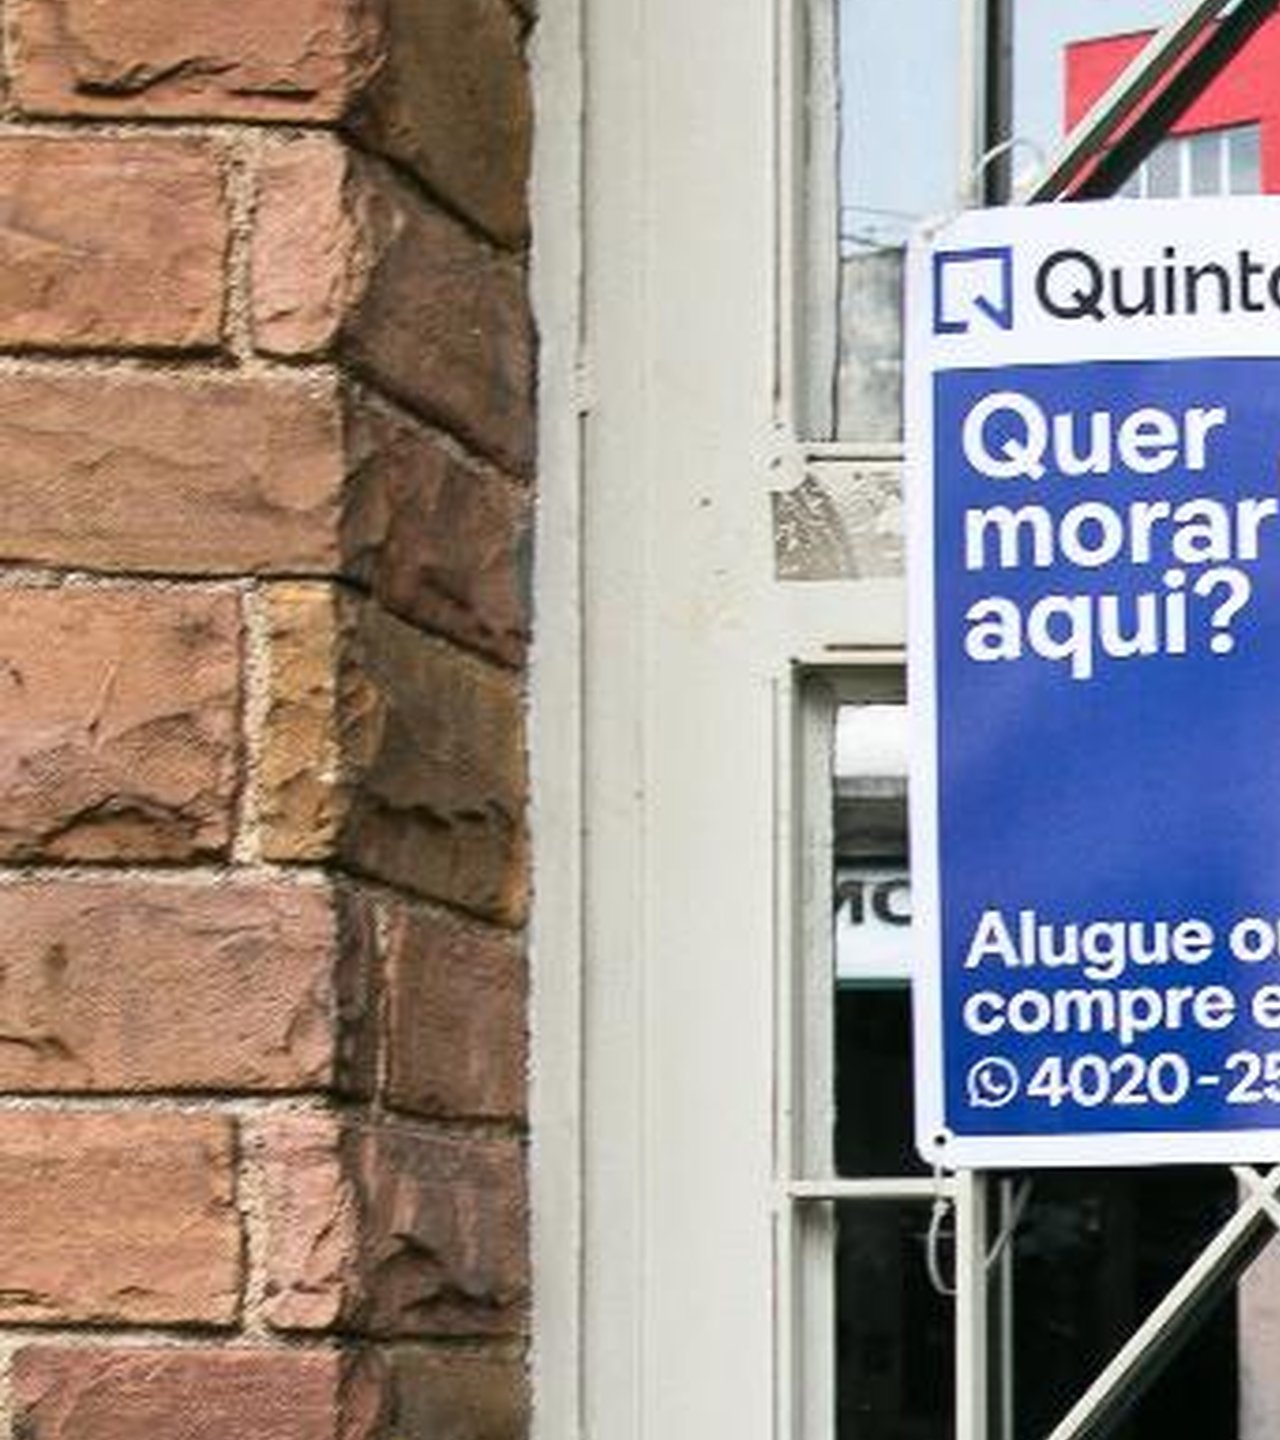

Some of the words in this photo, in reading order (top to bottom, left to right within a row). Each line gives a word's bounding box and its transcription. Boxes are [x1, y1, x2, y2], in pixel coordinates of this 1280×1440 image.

[963, 392, 1226, 480] Quer
[966, 499, 1278, 569] morar
[966, 568, 1250, 679] aqui?
[965, 911, 1213, 979] Alugue
[965, 978, 1234, 1043] compre
